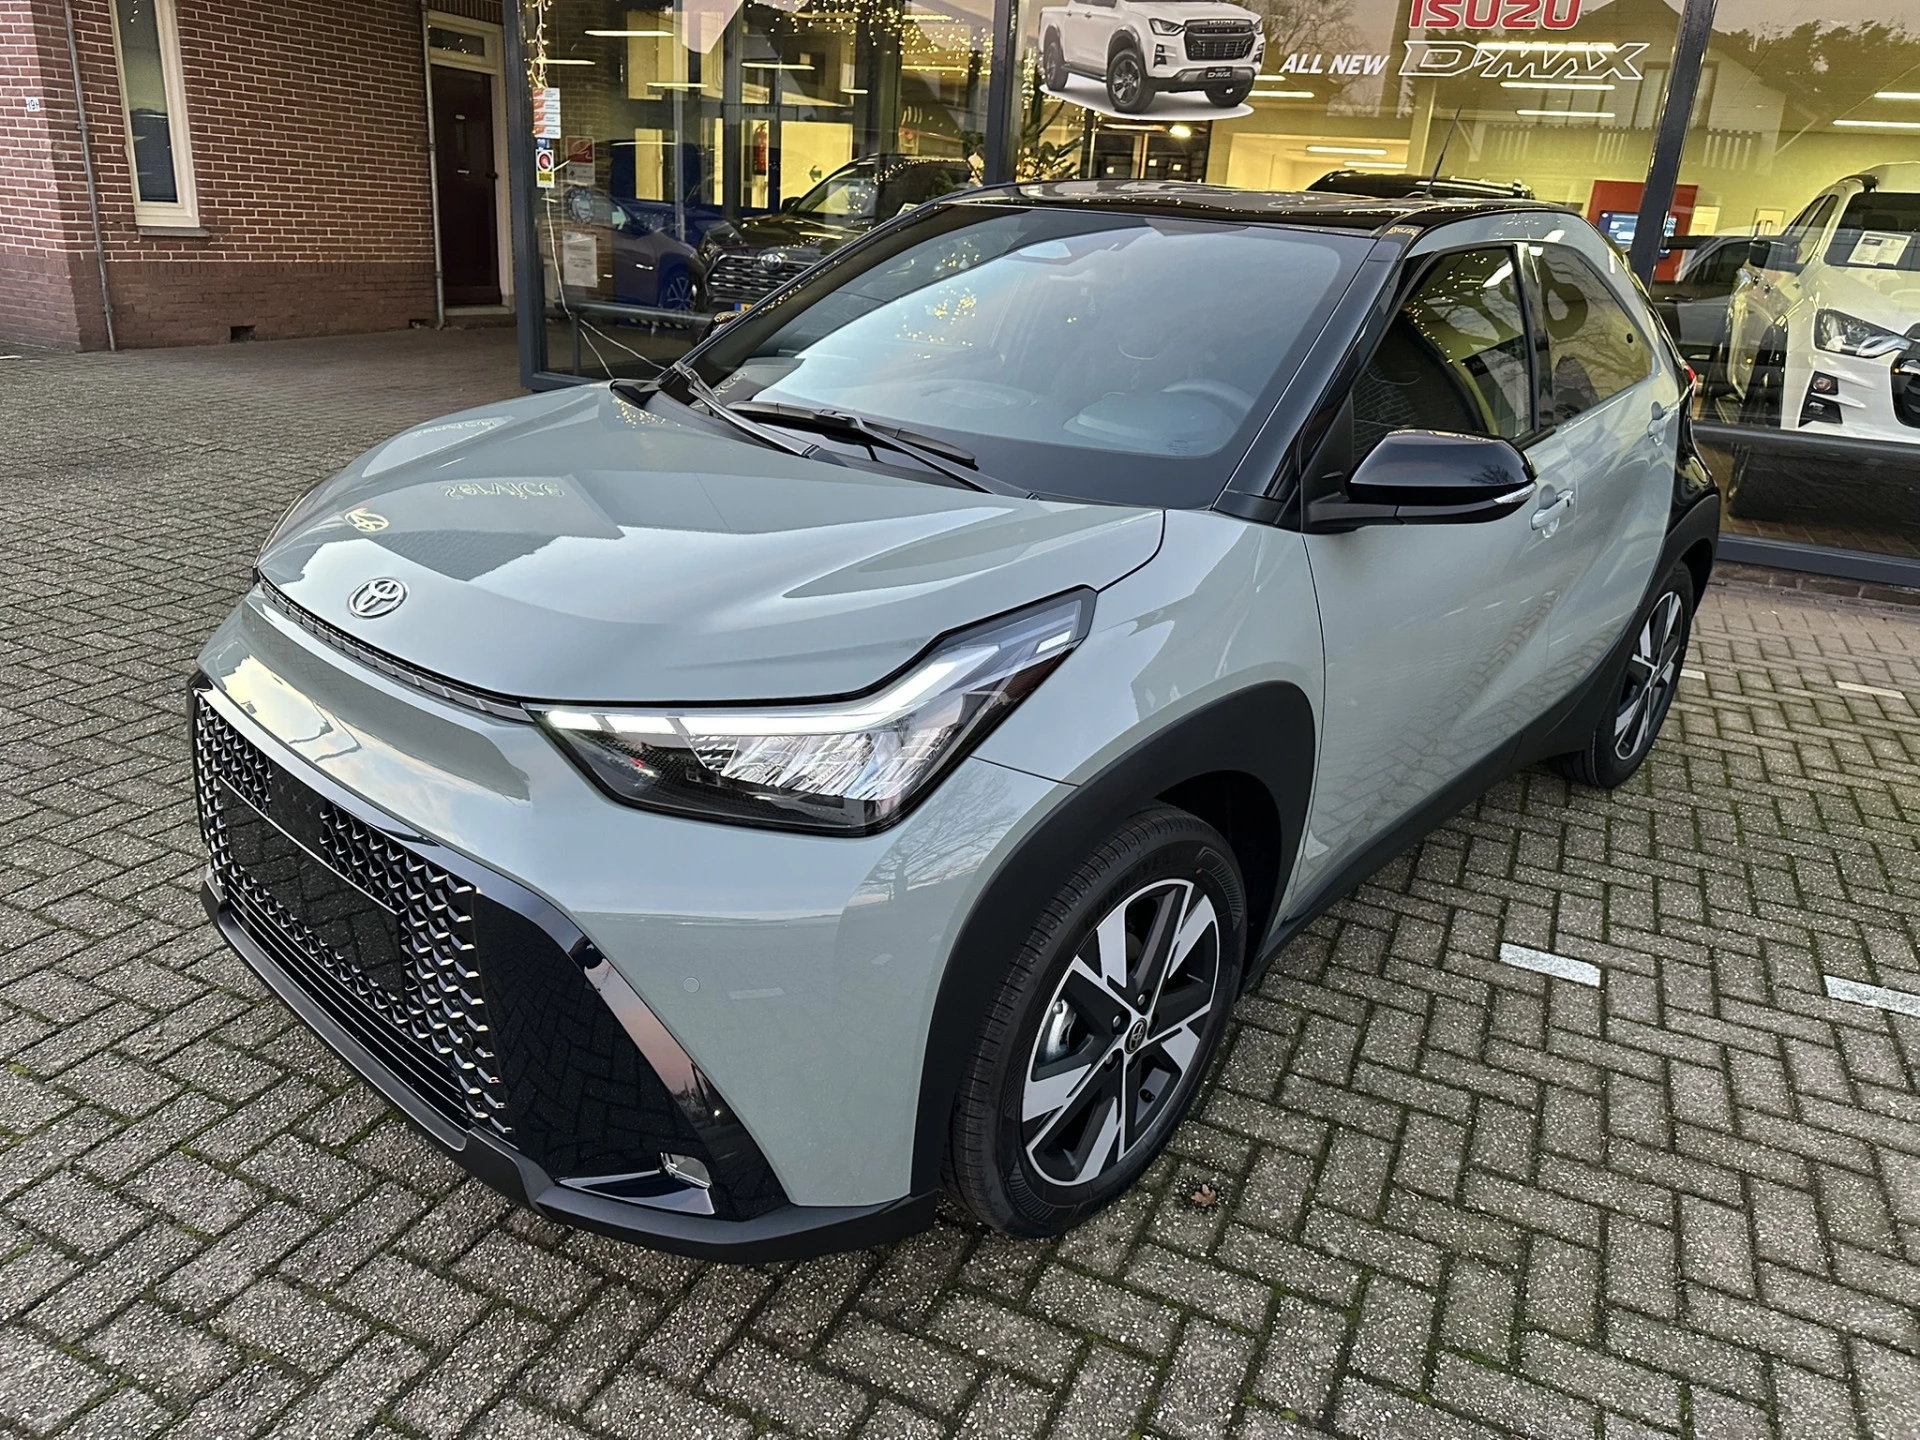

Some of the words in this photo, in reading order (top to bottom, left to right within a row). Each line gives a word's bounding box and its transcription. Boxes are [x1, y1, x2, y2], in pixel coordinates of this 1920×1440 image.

[1409, 0, 1582, 29] ISUZU
[1278, 53, 1324, 74] ALL
[1328, 55, 1391, 76] NEW
